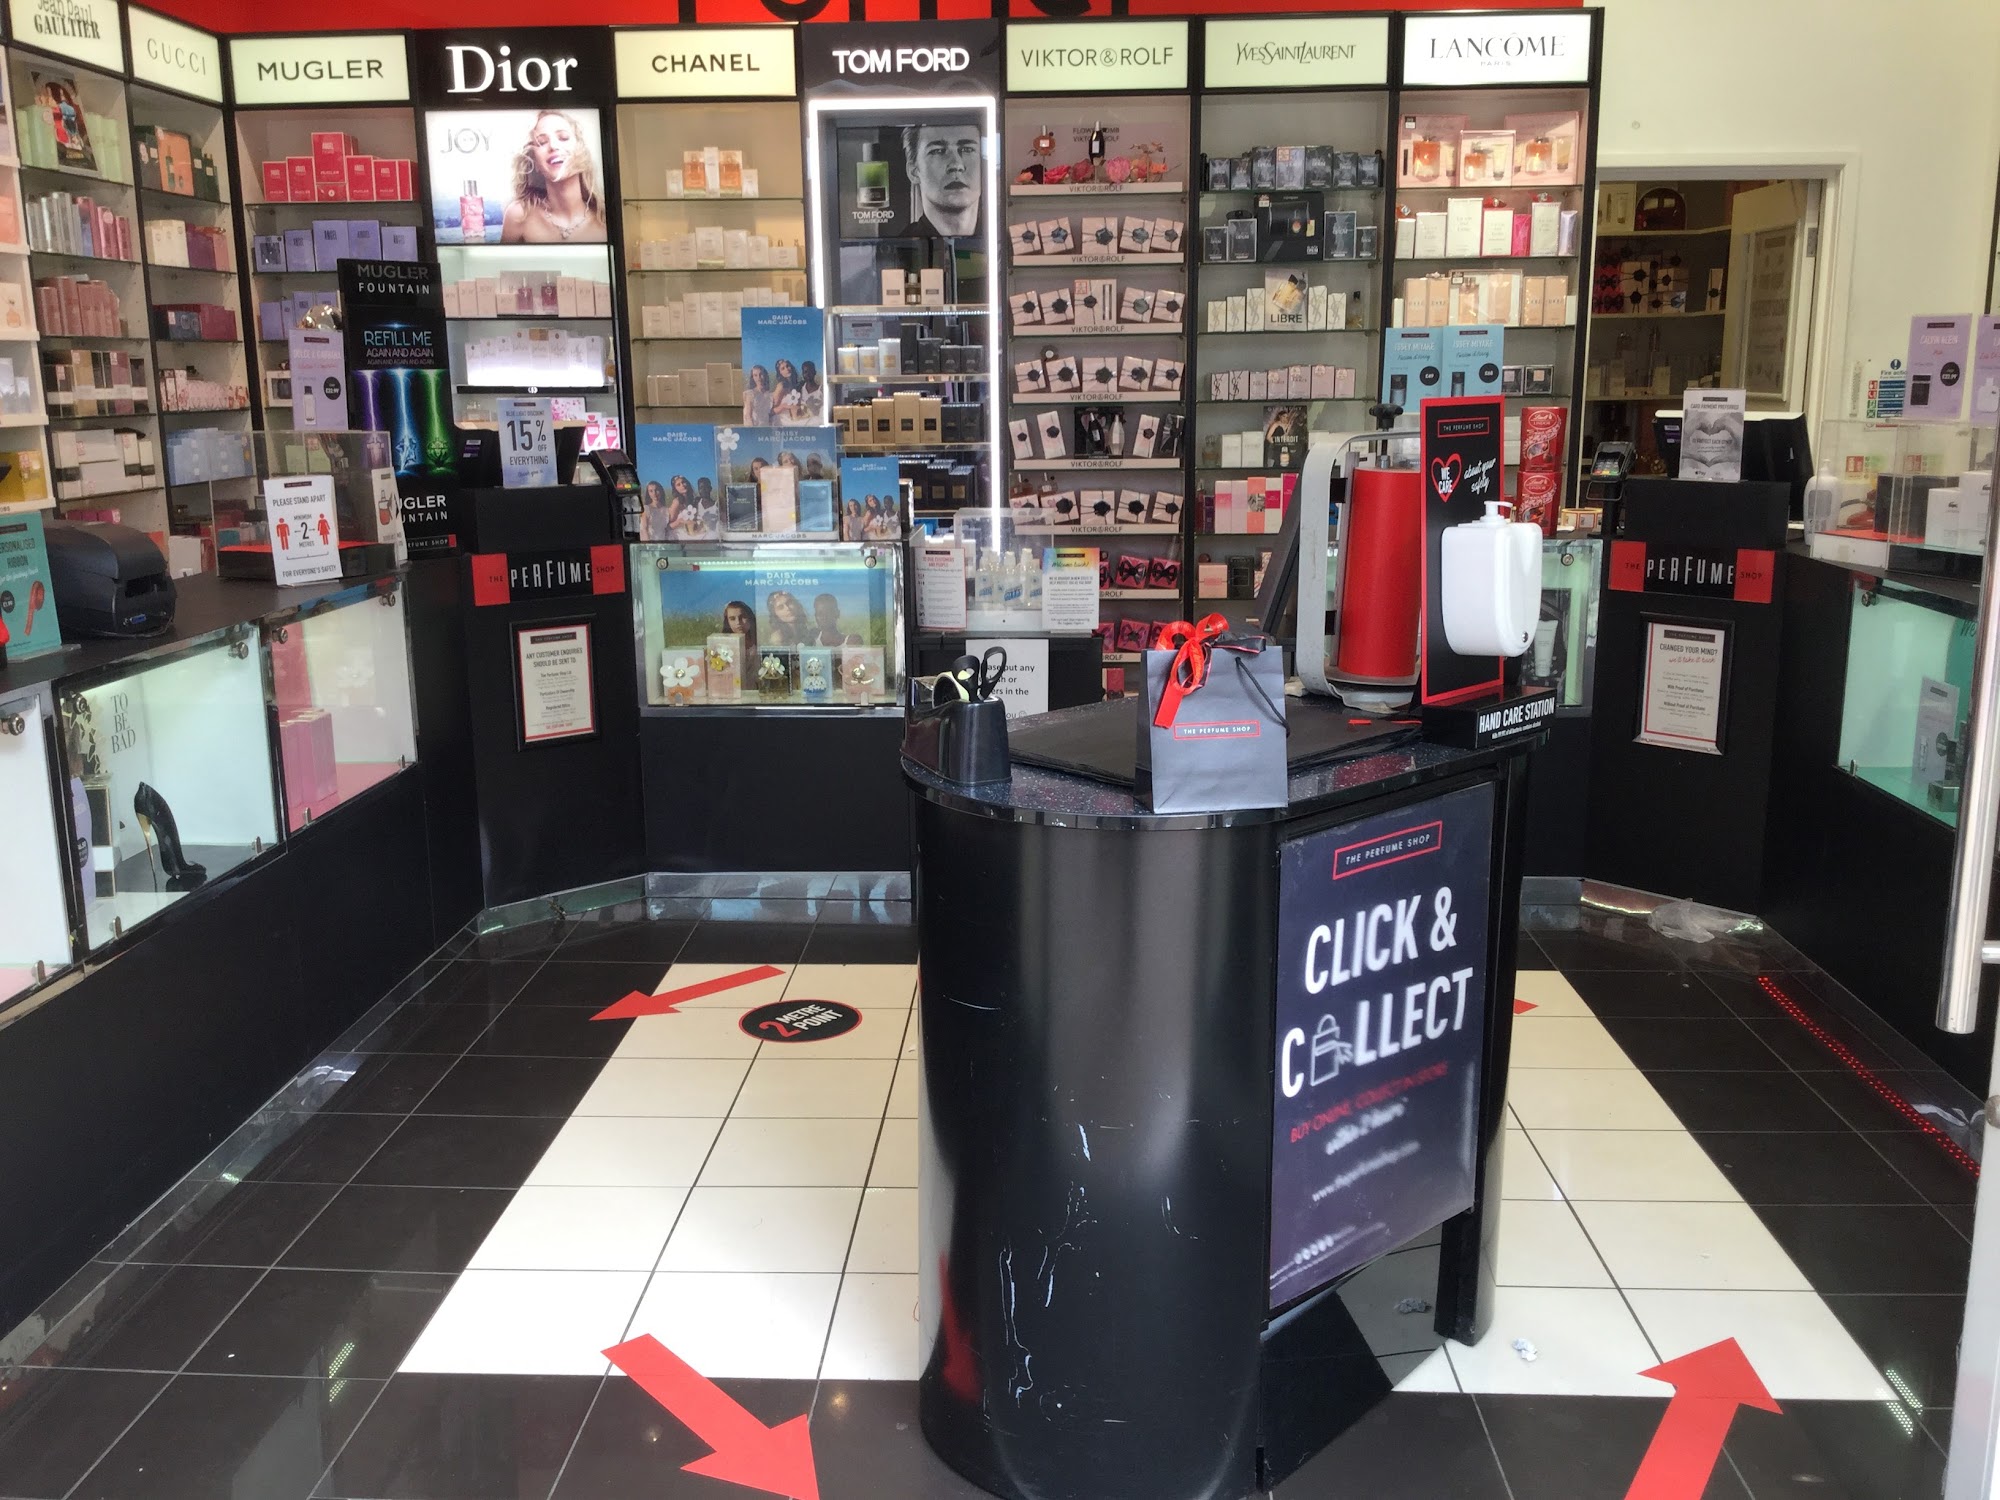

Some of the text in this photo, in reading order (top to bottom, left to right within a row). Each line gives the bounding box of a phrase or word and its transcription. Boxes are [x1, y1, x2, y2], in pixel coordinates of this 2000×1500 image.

[37, 0, 65, 17] Jean
[34, 15, 101, 39] GAULTIER
[1430, 32, 1565, 59] LANCÔME
[147, 38, 206, 75] GUCCI
[652, 53, 760, 74] CHANEL
[832, 47, 970, 74] TOM FORD
[258, 59, 384, 81] MUGLER
[446, 46, 578, 93] Dior
[440, 128, 493, 153] JOY
[852, 210, 894, 219] TOM FORD
[357, 264, 429, 280] MUGLER
[359, 283, 430, 294] FOUNTAIN
[1271, 314, 1303, 324] LIBRE
[364, 331, 432, 346] REFILL ME
[366, 348, 434, 357] AGAIN AND AGAIN
[510, 456, 549, 465] EVERYTHING
[1441, 467, 1450, 480] WE
[1438, 480, 1453, 494] CARE
[272, 494, 326, 507] PLEASE STAND APART
[399, 495, 446, 509] GLER
[402, 511, 447, 523] UNTAIN
[301, 522, 309, 540] 2
[0, 538, 35, 553] ERSONALISED
[321, 565, 336, 573] SAFETY
[489, 575, 504, 583] THE
[511, 560, 591, 588] PERFUME
[1646, 556, 1734, 584] PERFUME
[1740, 571, 1762, 580] SHOP
[536, 650, 559, 658] CUSTOMER
[561, 648, 583, 656] ENQUIRIES
[1660, 643, 1684, 652] CHANGED
[1685, 646, 1699, 654] YOUR
[110, 692, 129, 713] TO
[113, 712, 130, 733] BE
[1479, 711, 1501, 733] HAND
[1503, 705, 1524, 727] CARE
[1525, 697, 1555, 720] STATION
[111, 729, 136, 754] BAD
[1345, 834, 1430, 865] THE PERFUME SHOP
[1305, 886, 1457, 995] CLICK &
[776, 1004, 826, 1024] METRE
[792, 1009, 843, 1031] POINT
[759, 1021, 801, 1038] 2
[1290, 1122, 1309, 1143] BUY
